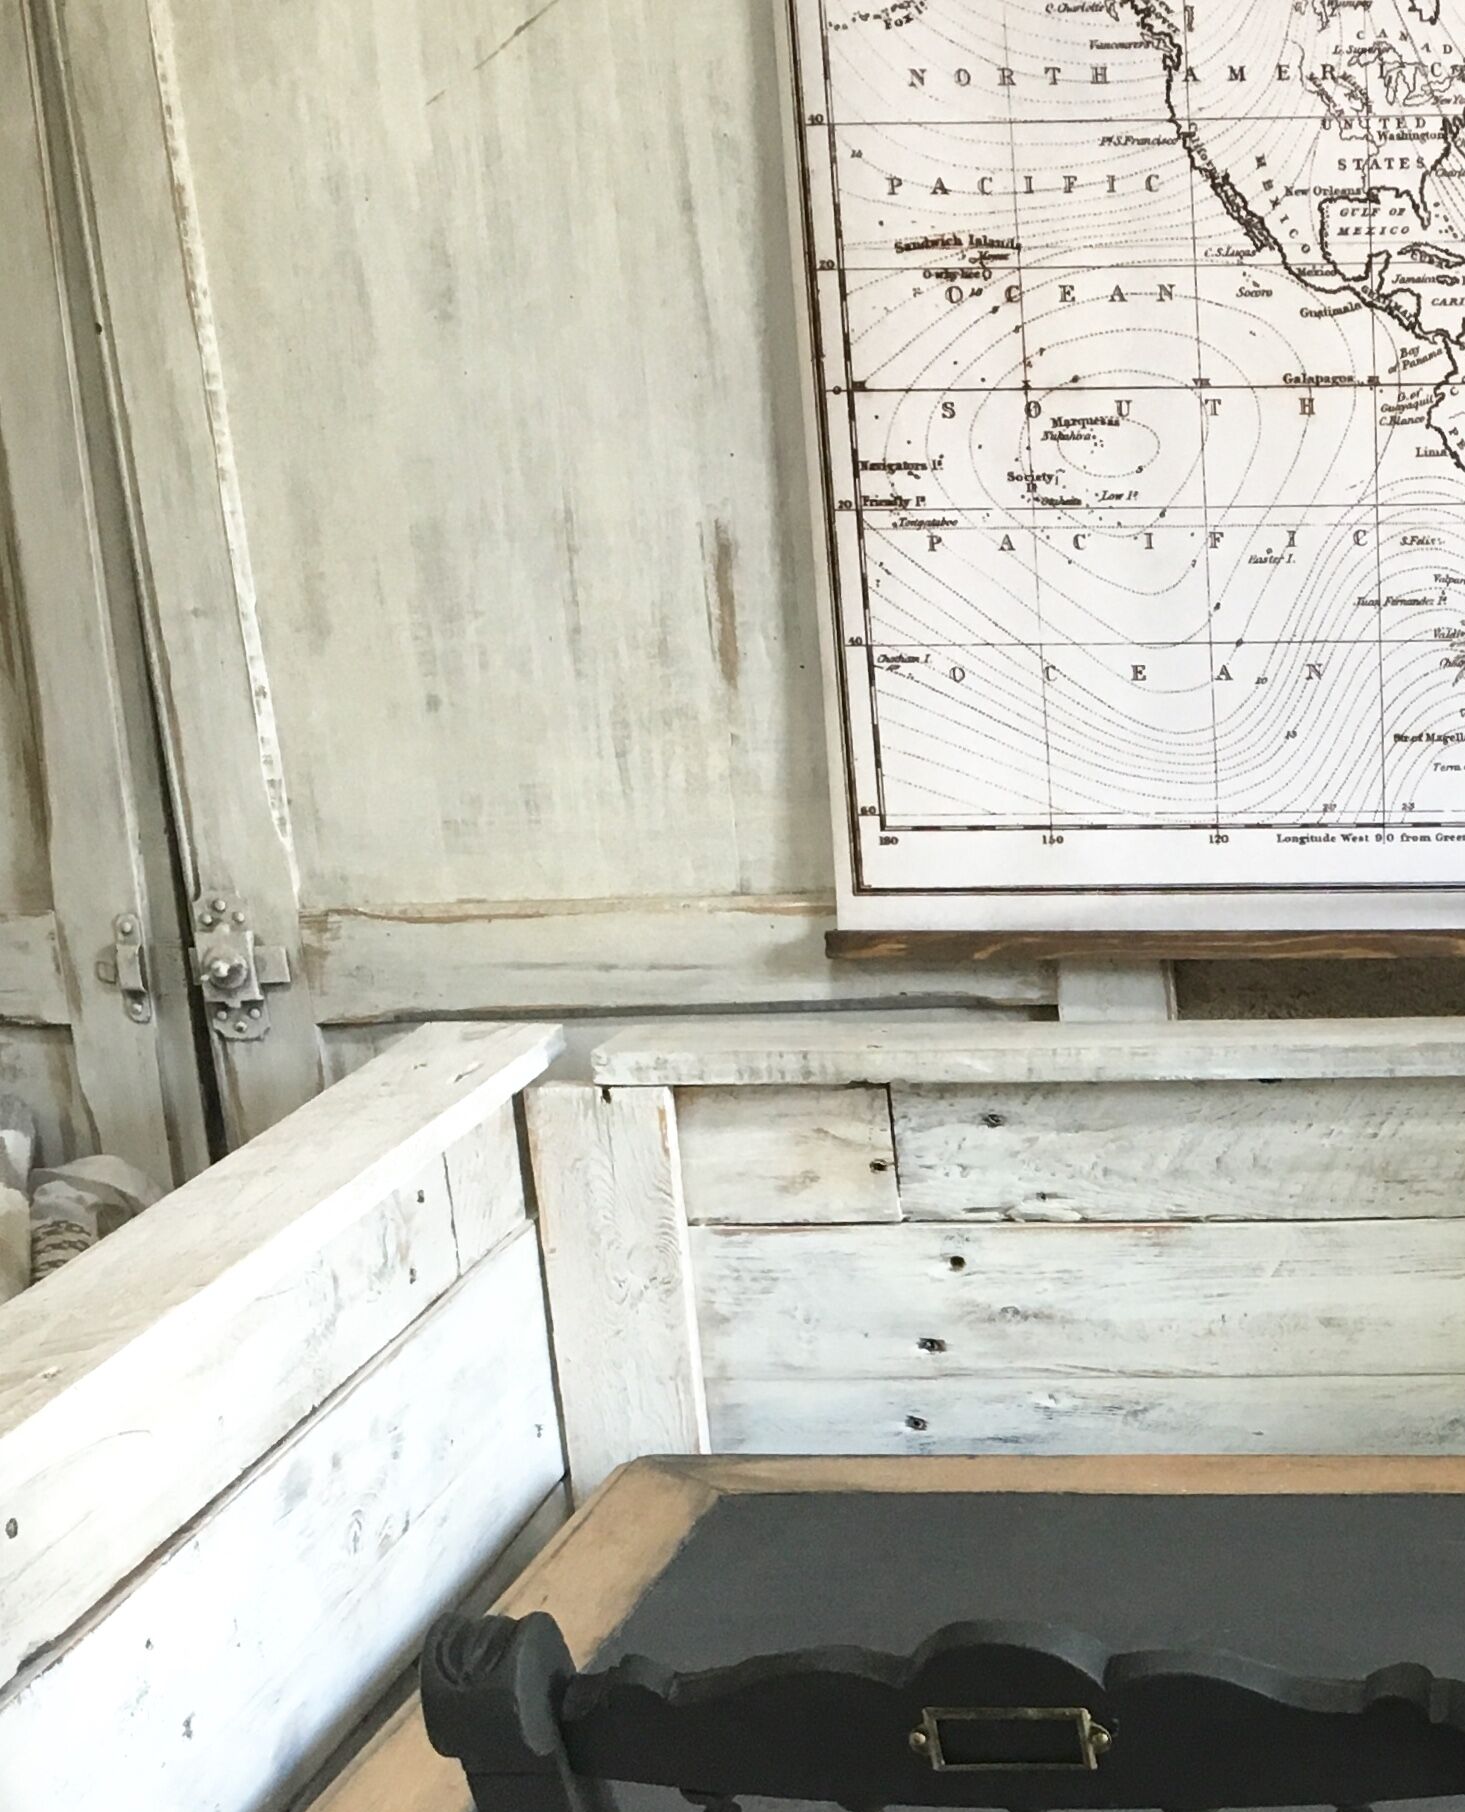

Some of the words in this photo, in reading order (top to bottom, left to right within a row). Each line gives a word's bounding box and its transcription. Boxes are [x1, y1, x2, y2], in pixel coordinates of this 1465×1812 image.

[908, 65, 1109, 88] NORTH
[1321, 117, 1426, 130] UNITED
[1377, 130, 1444, 143] Washington
[1338, 157, 1425, 170] STATES
[886, 174, 1160, 196] PACIFIC
[1284, 187, 1309, 196] New
[1313, 186, 1362, 196] Orleans
[944, 283, 1176, 306] OCEAN
[941, 397, 1316, 421] SOUTH
[1007, 471, 1054, 484] Society
[928, 529, 1367, 552] PACIFIC
[950, 663, 1323, 683] OCEAN
[1209, 834, 1229, 845] 120
[1277, 833, 1336, 846] Longitude
[1341, 833, 1368, 843] West
[1400, 832, 1431, 843] from
